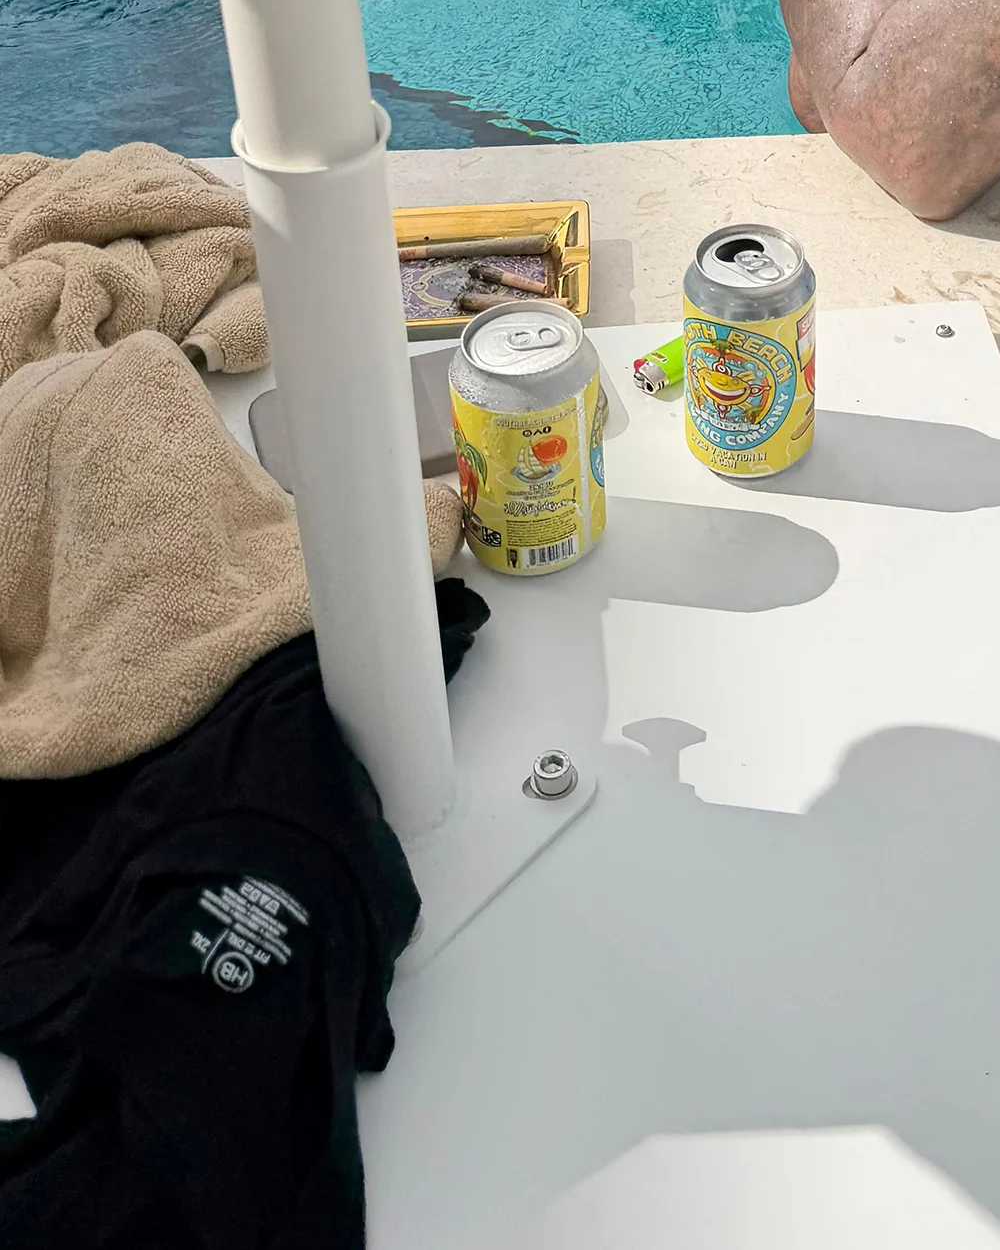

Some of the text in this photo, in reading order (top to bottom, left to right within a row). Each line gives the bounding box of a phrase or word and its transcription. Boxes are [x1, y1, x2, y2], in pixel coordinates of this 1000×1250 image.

[727, 328, 793, 384] BEACH
[725, 393, 789, 447] COMPANY
[191, 930, 211, 953] 2XL
[253, 949, 271, 965] FIT
[219, 961, 249, 986] HB
